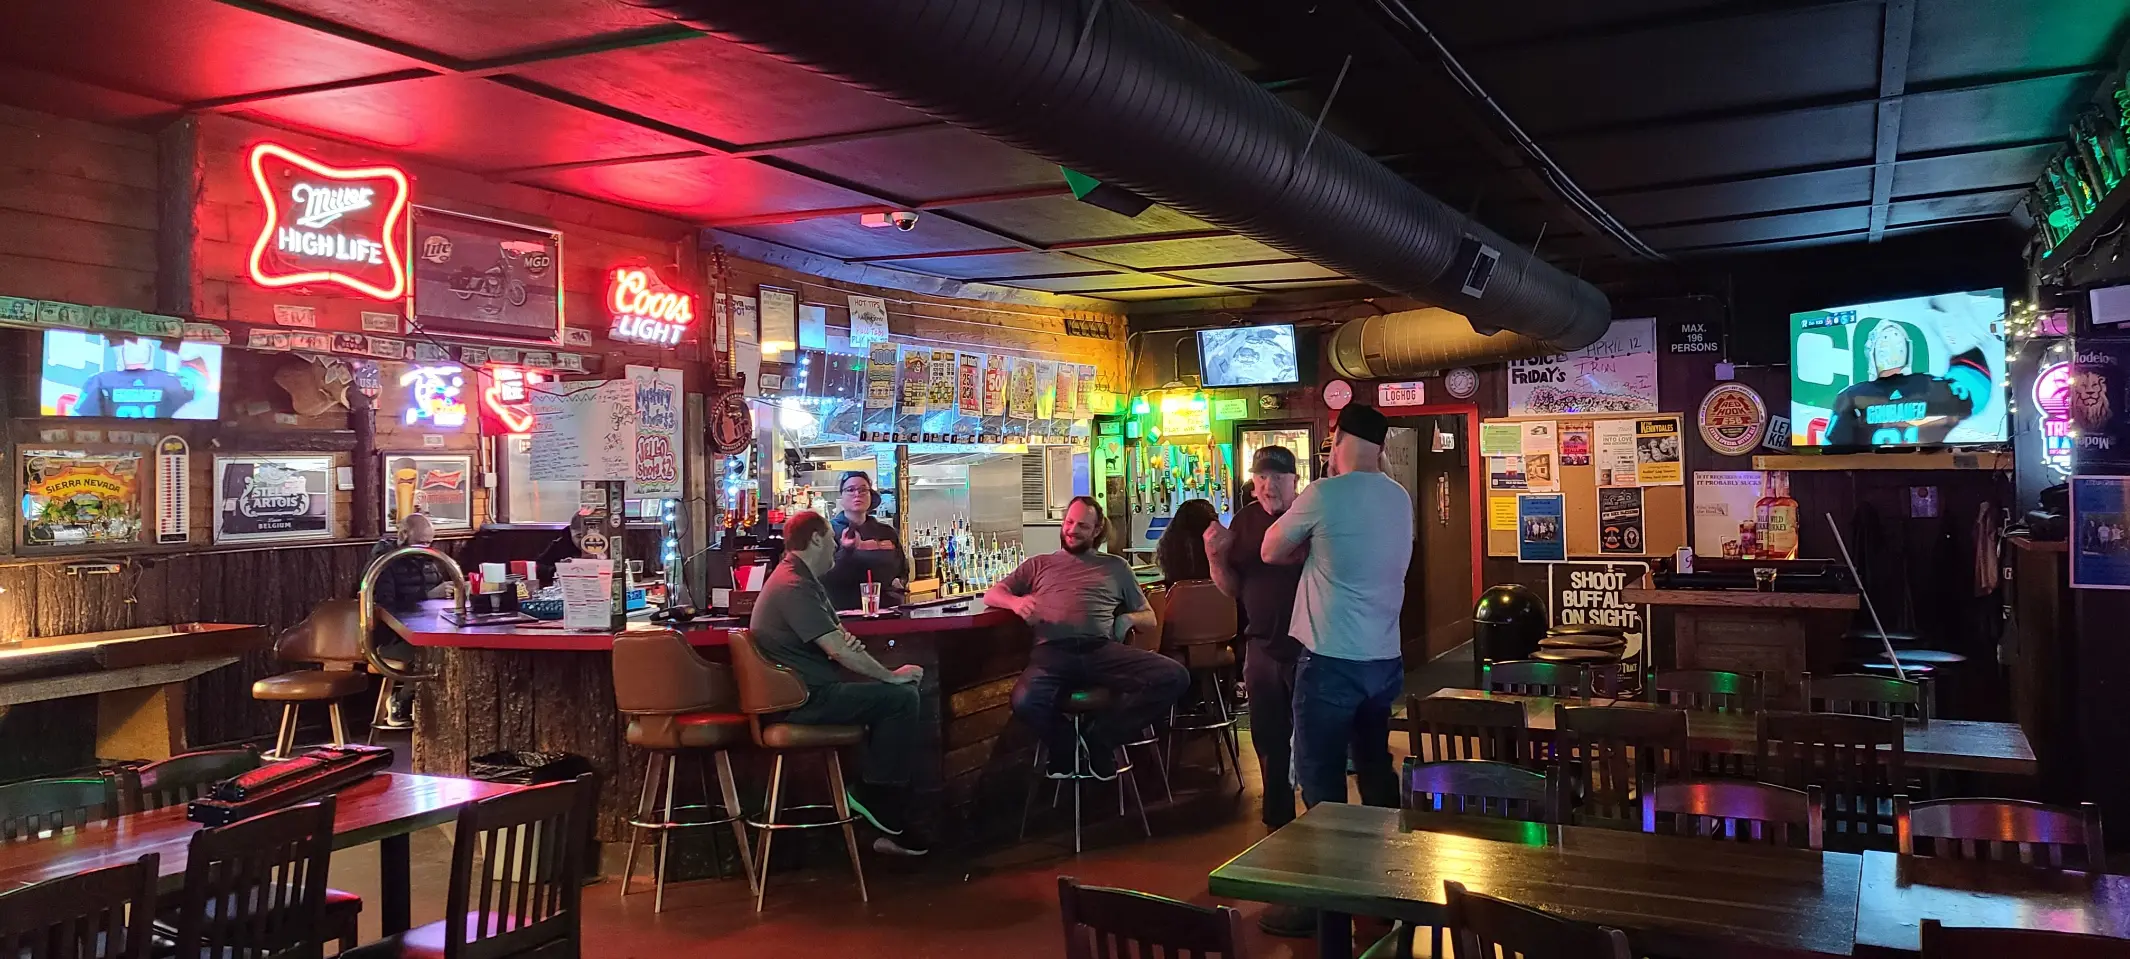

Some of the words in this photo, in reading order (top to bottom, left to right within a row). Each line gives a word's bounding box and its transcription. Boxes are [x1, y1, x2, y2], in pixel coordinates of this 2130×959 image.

[292, 183, 374, 220] Miller
[278, 226, 333, 257] HIGH
[336, 233, 384, 265] LIFE
[421, 242, 453, 260] Lite
[523, 256, 550, 268] MGD
[615, 269, 693, 323] Coors
[619, 315, 687, 345] LIGHT
[1681, 323, 1707, 333] MAX.
[1629, 338, 1642, 349] 12
[1687, 333, 1703, 342] 196
[1671, 342, 1718, 352] PERSONS
[360, 378, 379, 389] USA
[1385, 389, 1416, 402] LOGHOG
[1716, 408, 1747, 416] HOOK
[1723, 416, 1742, 425] ESB
[45, 478, 82, 494] SIERRA
[84, 478, 121, 494] NEVADA
[253, 496, 298, 508] ARTOIS
[258, 522, 292, 530] BELGIUM
[1570, 570, 1627, 591] SHOOT
[1561, 609, 1585, 625] ON
[1588, 609, 1638, 628] SIGHT
